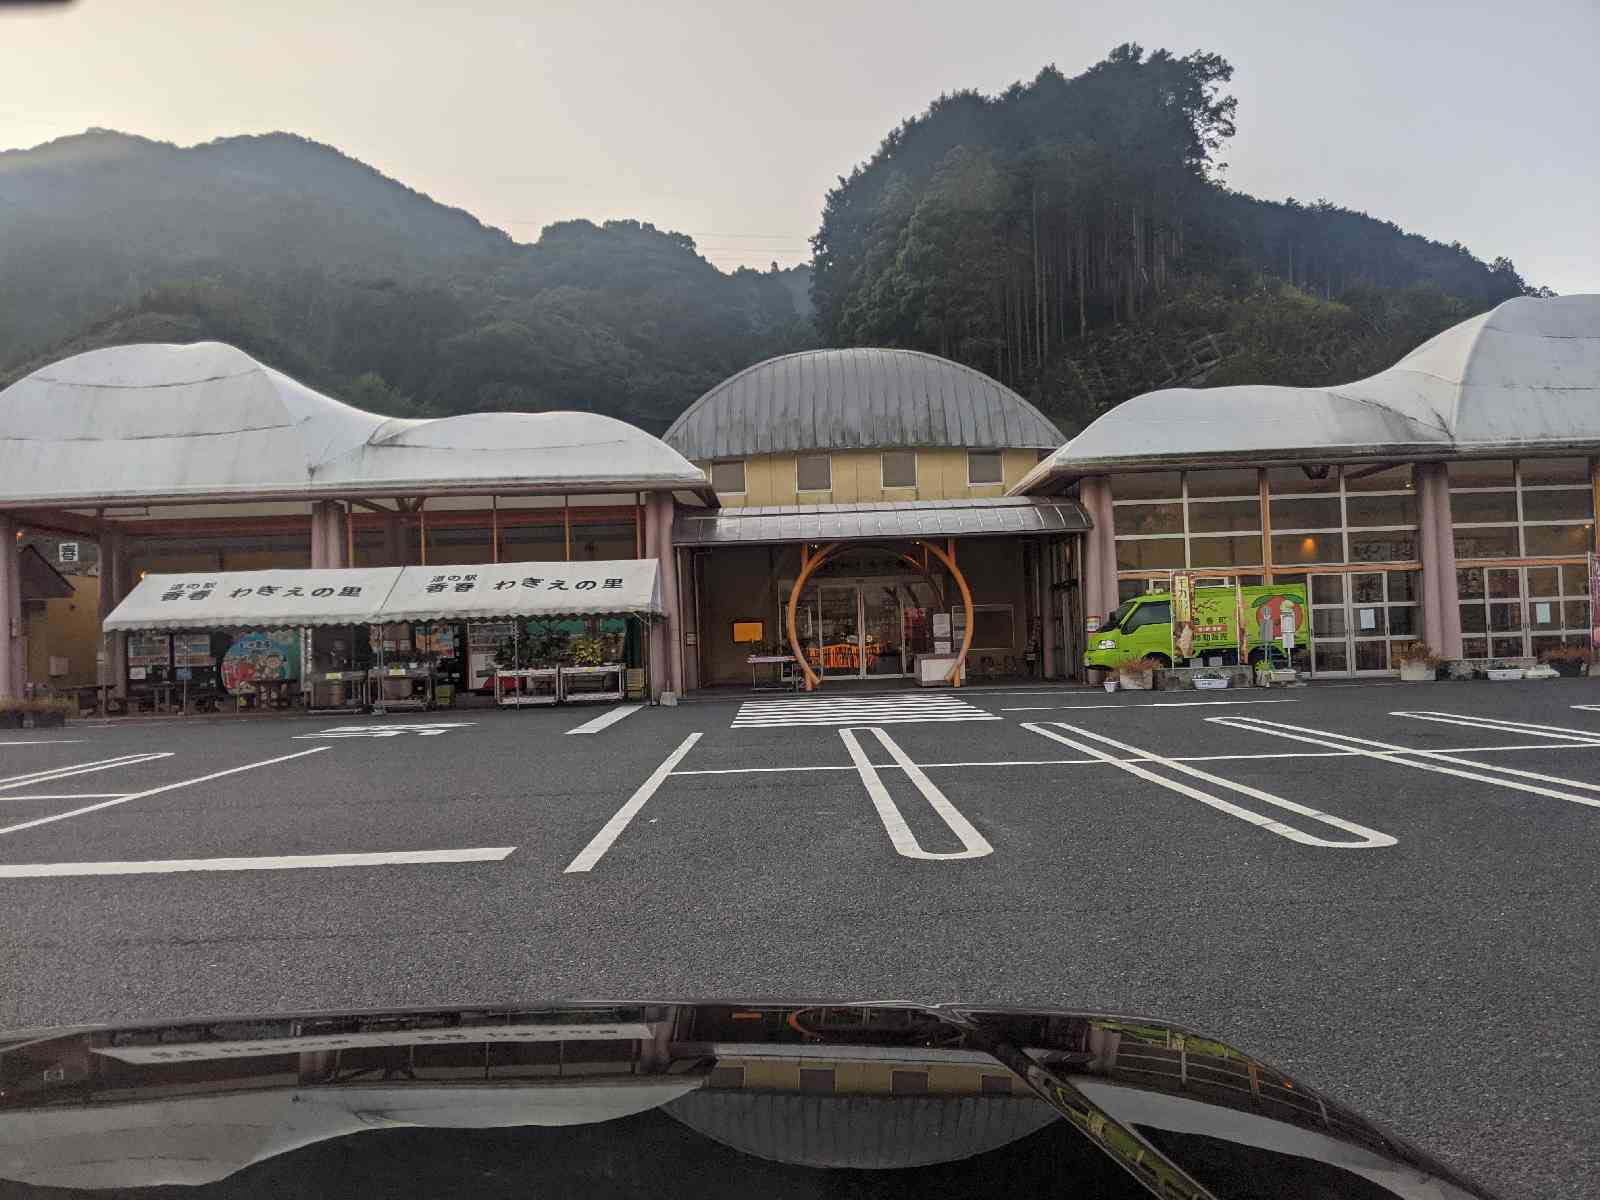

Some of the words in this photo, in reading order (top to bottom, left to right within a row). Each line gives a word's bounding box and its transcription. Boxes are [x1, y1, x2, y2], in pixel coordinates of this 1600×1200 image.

[432, 574, 478, 582] 道の駅
[493, 577, 624, 591] わぎえの里
[229, 585, 362, 598] わぎえの里
